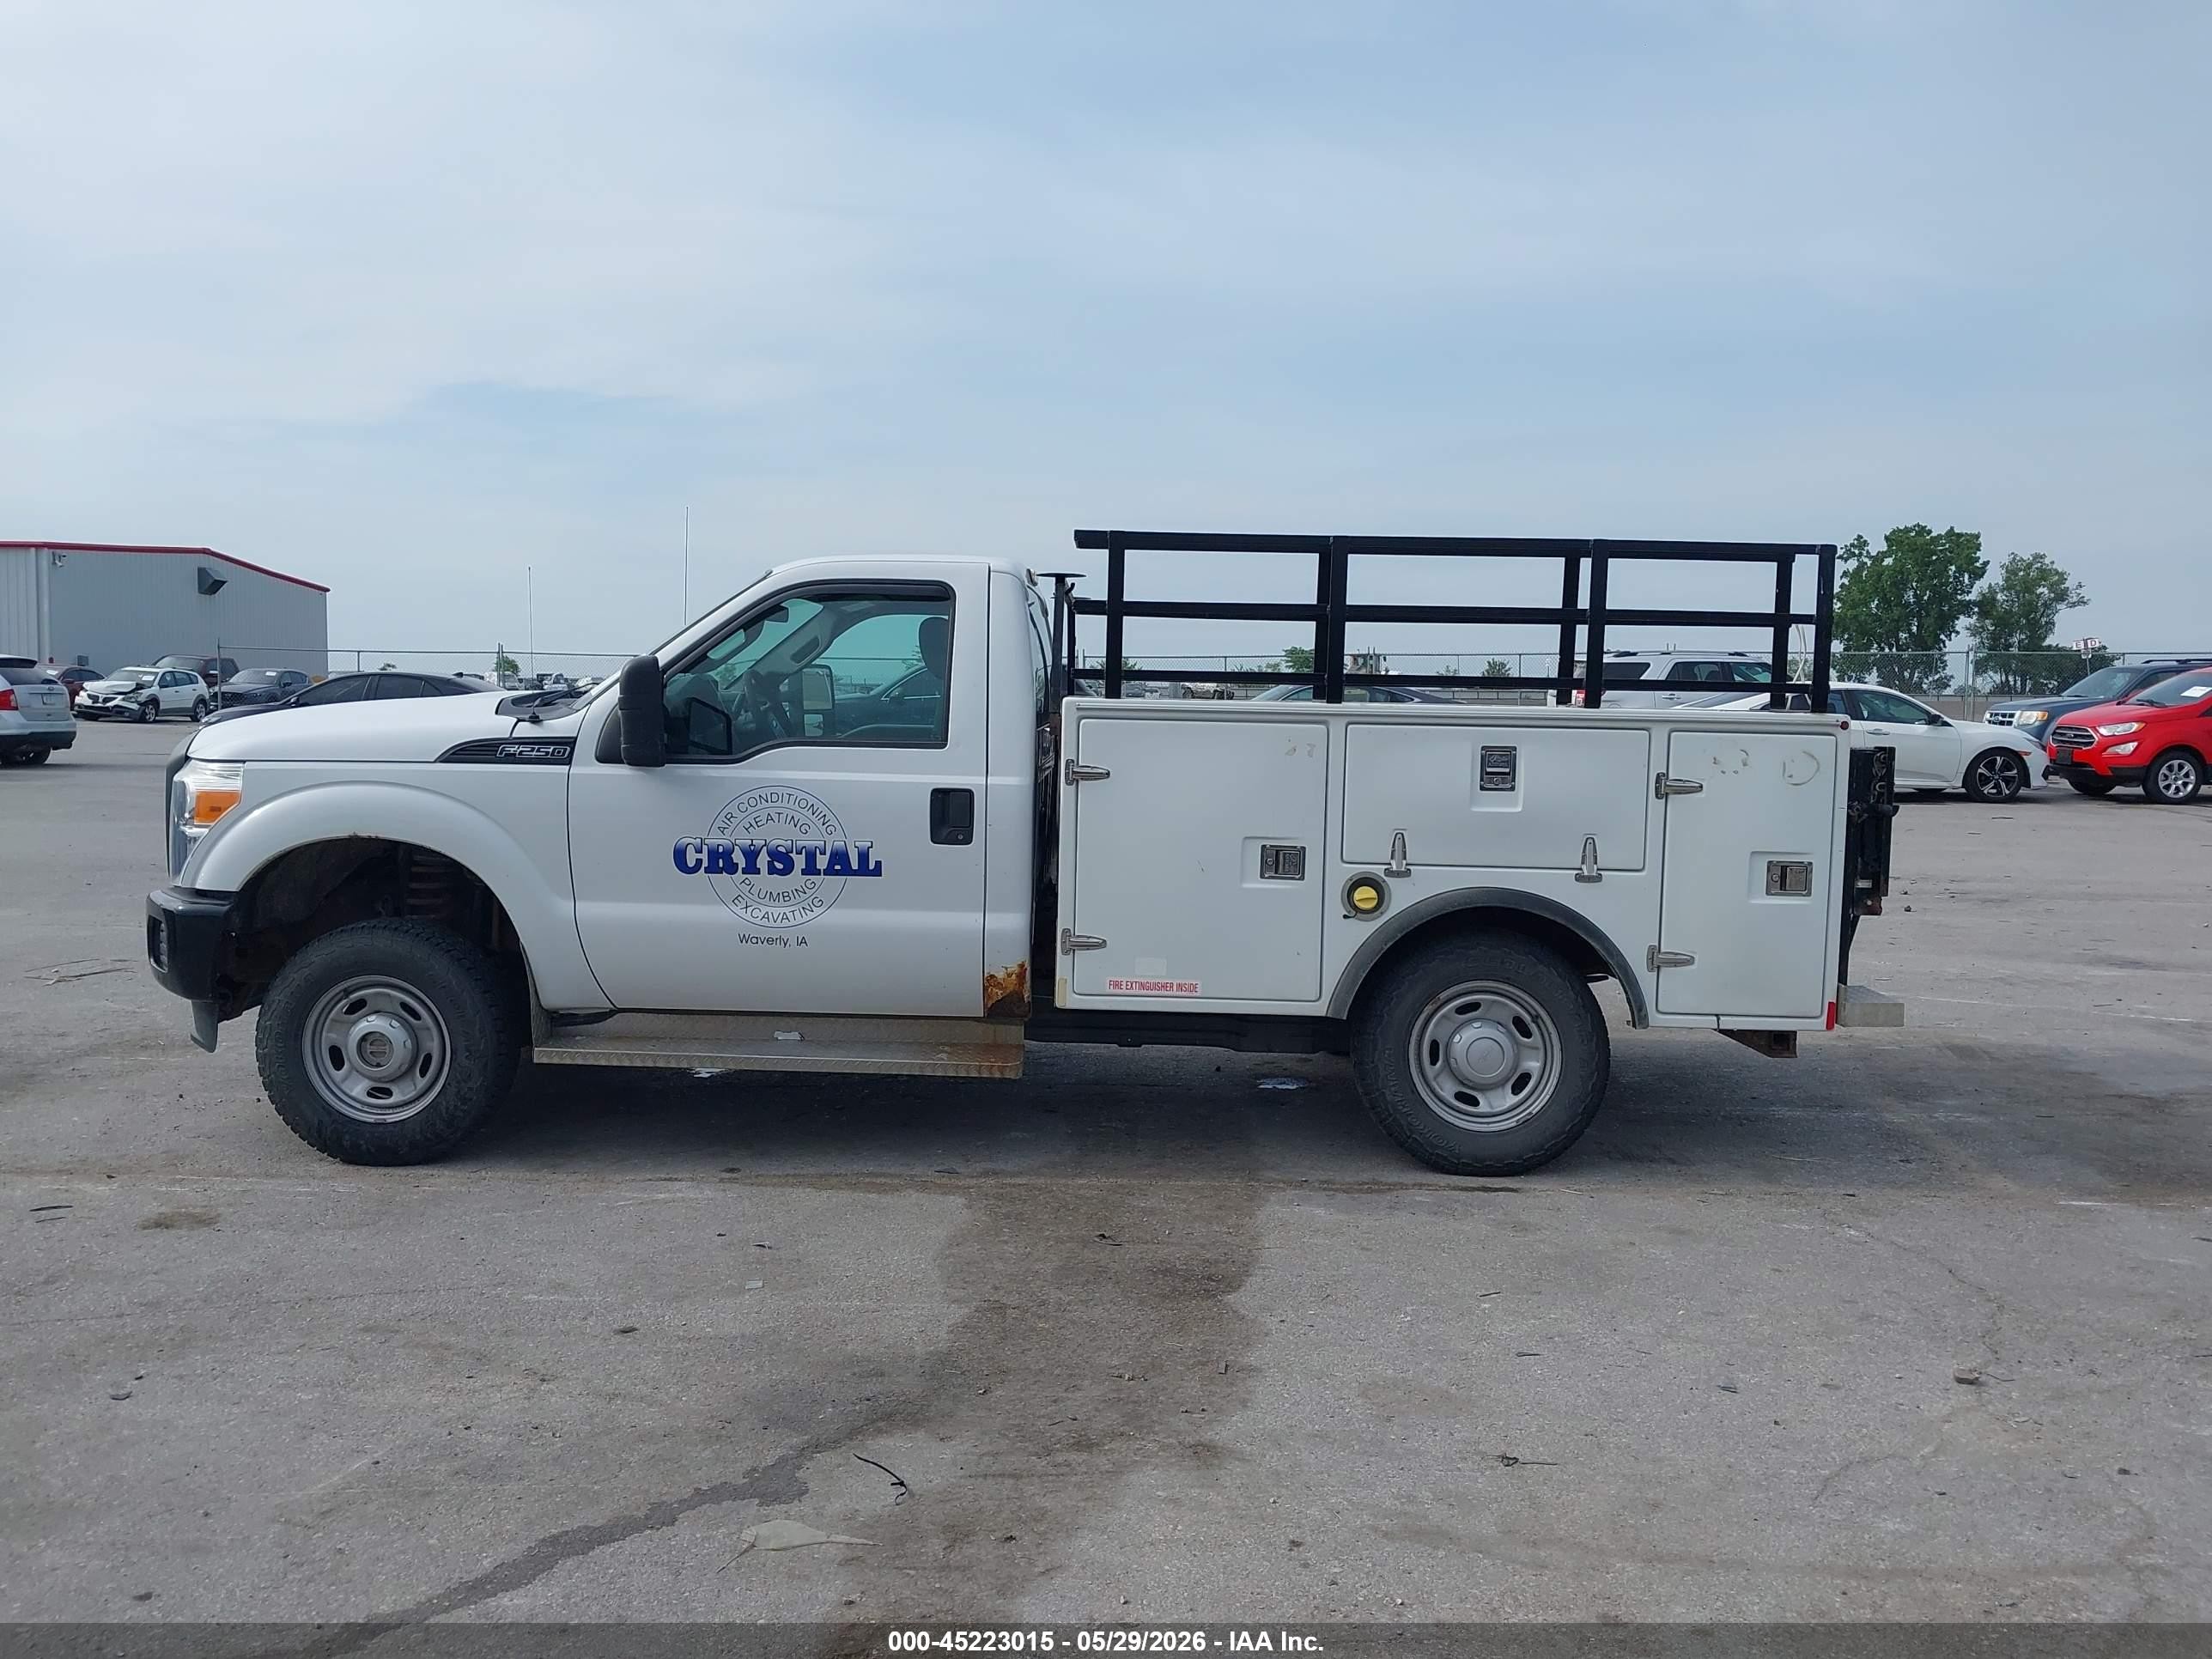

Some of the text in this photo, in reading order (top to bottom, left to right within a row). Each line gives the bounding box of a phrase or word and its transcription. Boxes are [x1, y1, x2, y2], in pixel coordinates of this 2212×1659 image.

[495, 744, 571, 759] F-250
[717, 792, 837, 836] AIR CONDITIONING
[742, 811, 811, 836] HEATING
[672, 836, 883, 878] CRYSTAL
[738, 877, 817, 903] PLUMBING
[731, 894, 824, 924] EXCAVATING
[738, 933, 809, 948] Waverly, IA
[1109, 980, 1199, 993] FIRE EXTINGUISHER INSIDE
